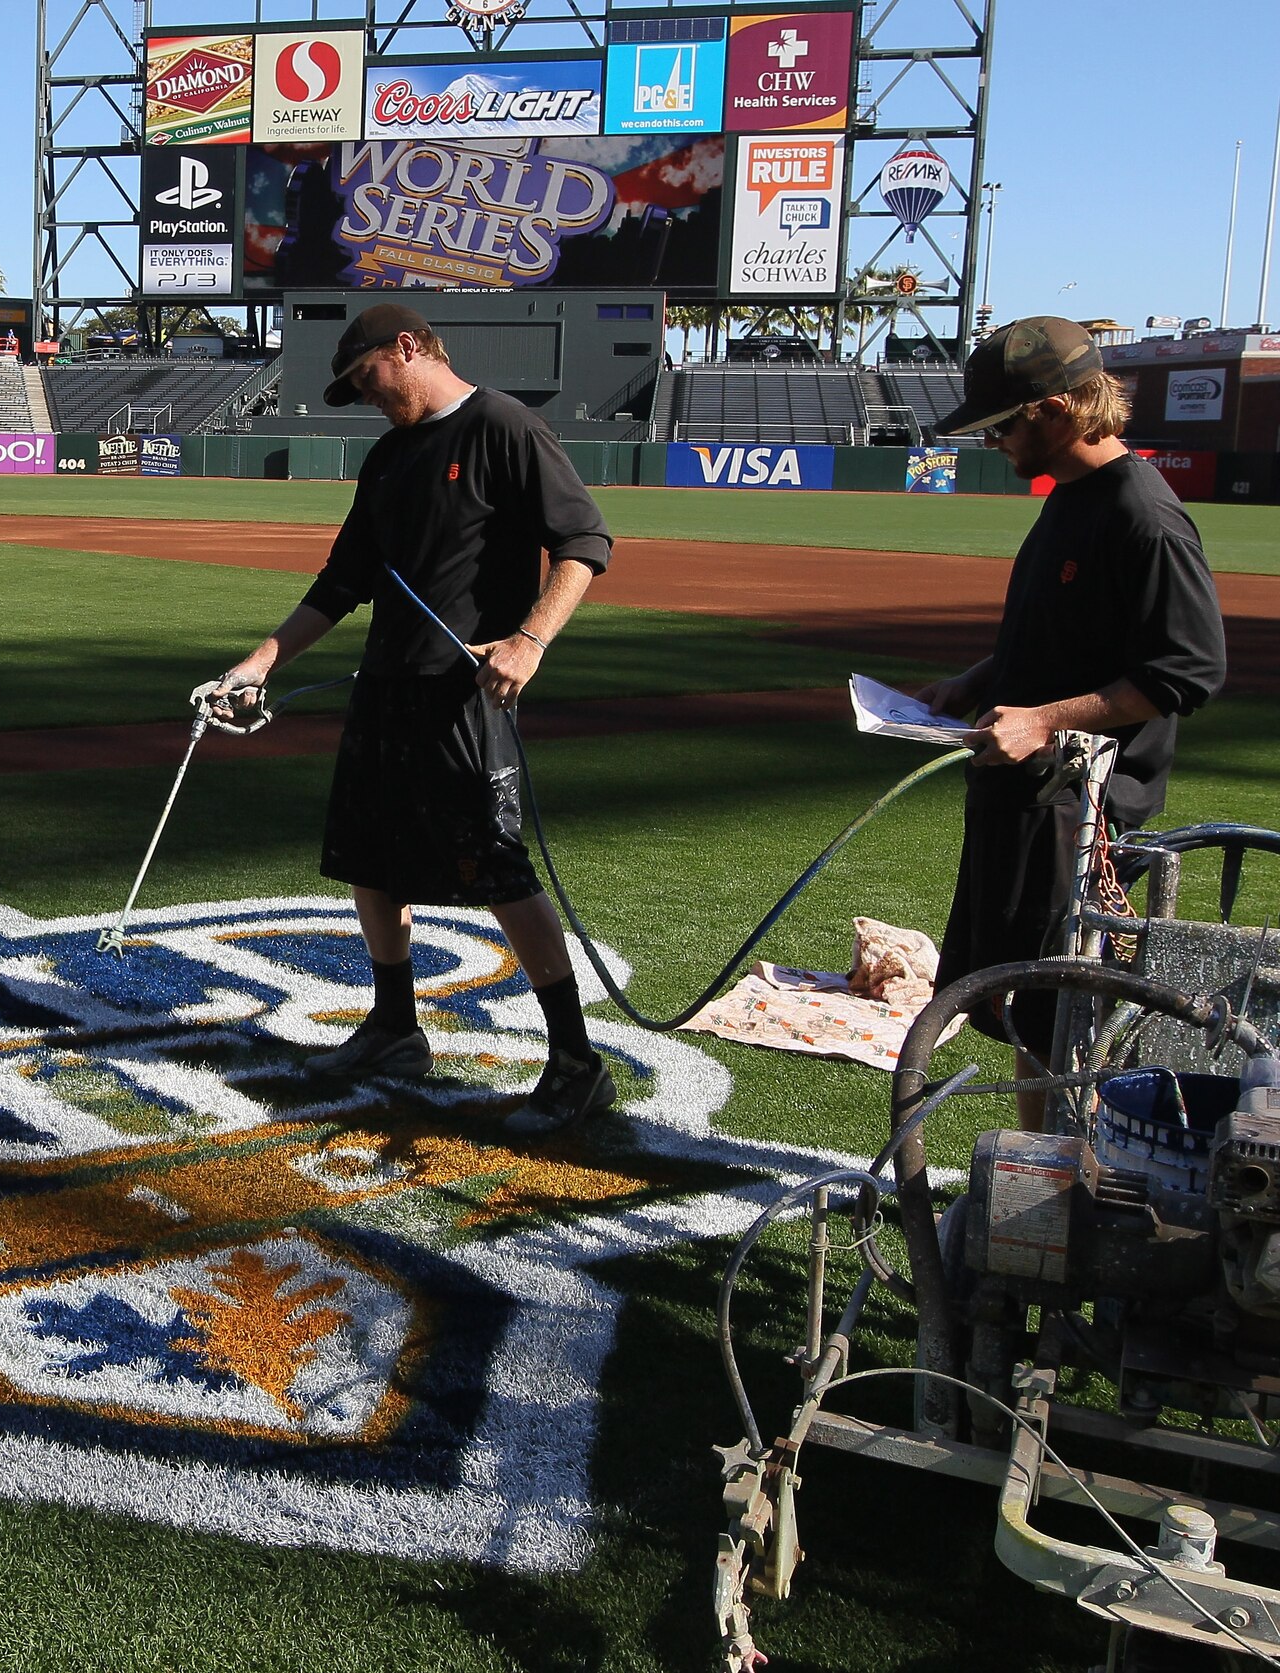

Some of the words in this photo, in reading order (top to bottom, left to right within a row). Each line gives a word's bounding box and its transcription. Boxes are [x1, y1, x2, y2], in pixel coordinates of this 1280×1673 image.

[445, 1, 527, 32] GIANTS
[155, 63, 245, 100] DIAMOND
[757, 71, 816, 92] CHW
[184, 84, 229, 98] CALIFORNIA
[638, 84, 691, 110] PG&E
[373, 79, 475, 125] Coors
[475, 89, 593, 121] LIGHT
[734, 94, 779, 109] Health
[781, 93, 837, 108] Services
[272, 108, 343, 124] SAFEWAY
[621, 119, 704, 129] wecandothis.com
[175, 124, 214, 139] Culinary
[213, 116, 250, 131] Walnuts
[266, 125, 316, 136] Ingredients
[316, 125, 329, 135] for
[329, 125, 348, 135] life.
[753, 147, 827, 160] INVESTORS
[751, 160, 827, 184] RULE
[888, 162, 943, 183] RE/MAX
[340, 141, 609, 223] WORLD
[785, 203, 806, 213] TALK
[807, 203, 819, 212] TO
[784, 212, 818, 222] CHUCK
[340, 181, 560, 275] SERIES
[187, 249, 213, 257] DOES
[743, 241, 827, 265] charles
[378, 248, 416, 264] FALL
[423, 257, 495, 280] CLASSIC
[158, 273, 217, 287] PS3
[740, 267, 828, 283] SCHWAB
[58, 458, 87, 470] 404
[690, 446, 802, 486] VISA
[1143, 453, 1192, 469] erica
[1231, 481, 1250, 495] 421
